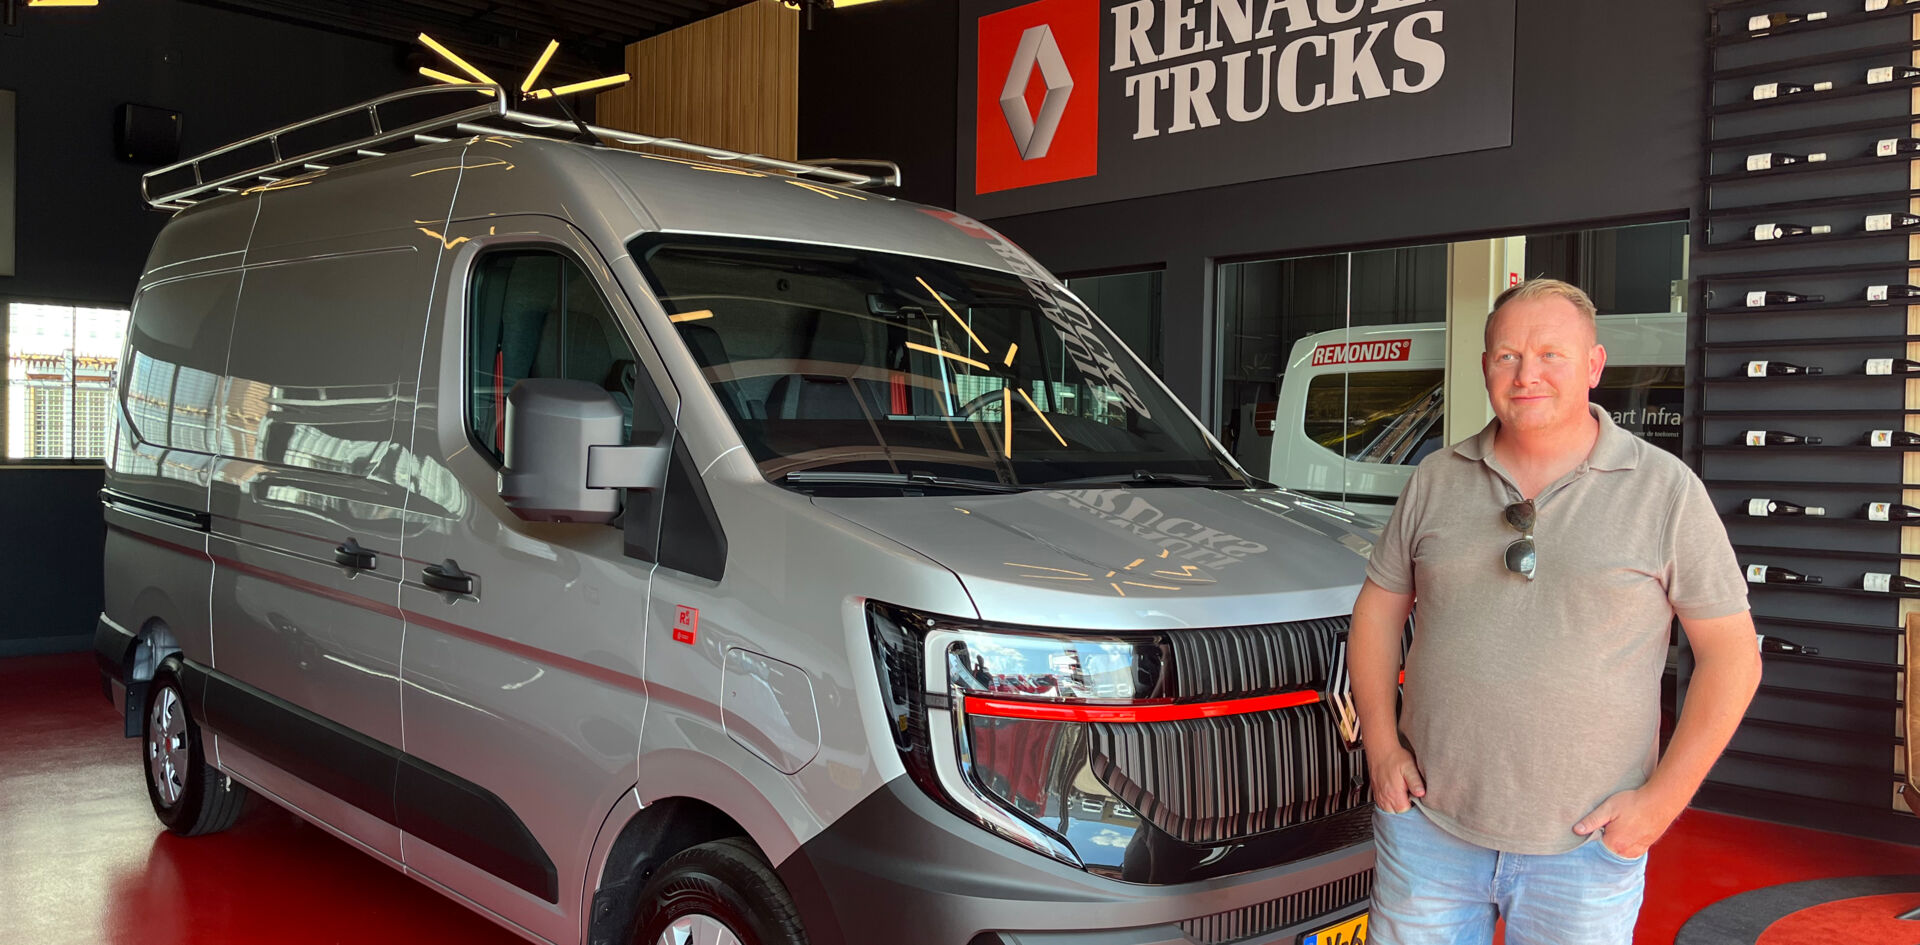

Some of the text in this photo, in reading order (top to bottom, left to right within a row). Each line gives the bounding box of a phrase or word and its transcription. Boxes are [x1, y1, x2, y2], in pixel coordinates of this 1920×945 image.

[1109, 0, 1437, 72] RENA
[1126, 10, 1446, 140] TRUCKS
[1607, 407, 1681, 426] art Infra
